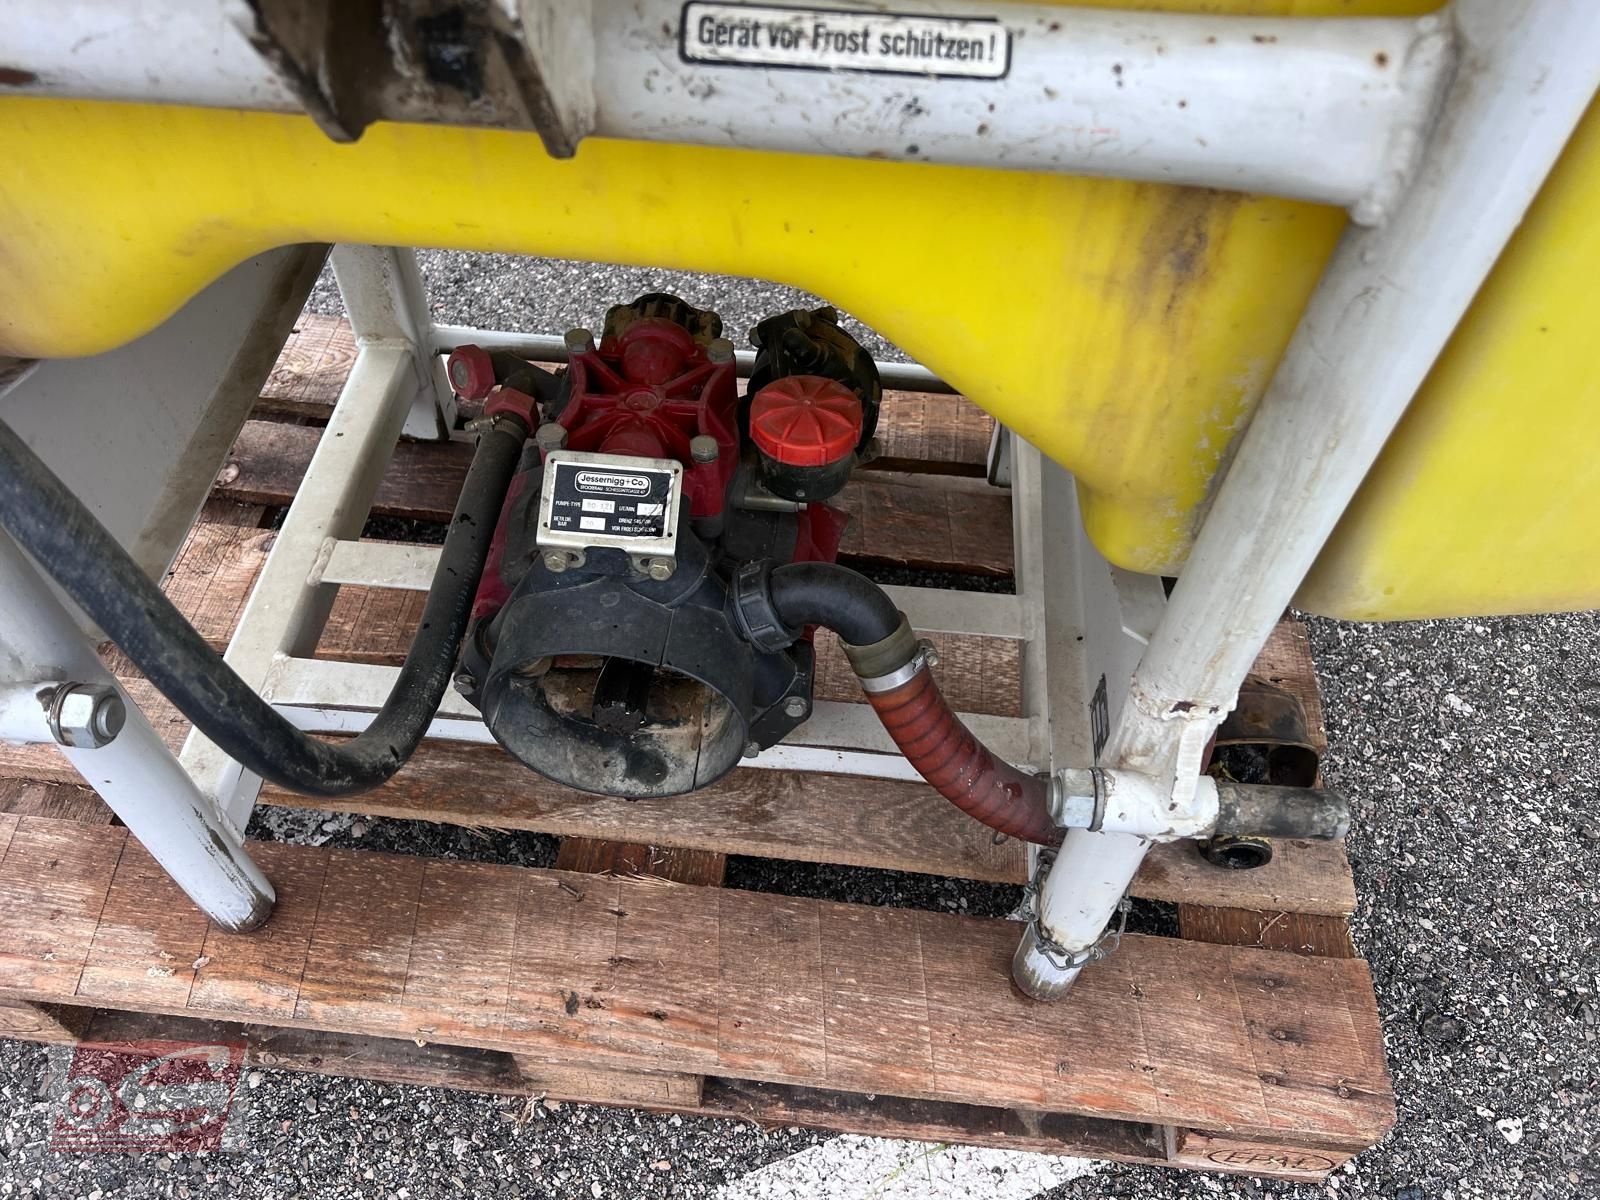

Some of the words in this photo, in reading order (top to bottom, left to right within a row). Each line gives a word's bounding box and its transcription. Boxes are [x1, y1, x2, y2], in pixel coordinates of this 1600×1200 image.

[698, 16, 762, 48] Gerät
[768, 23, 802, 49] vor
[811, 23, 871, 55] Frost
